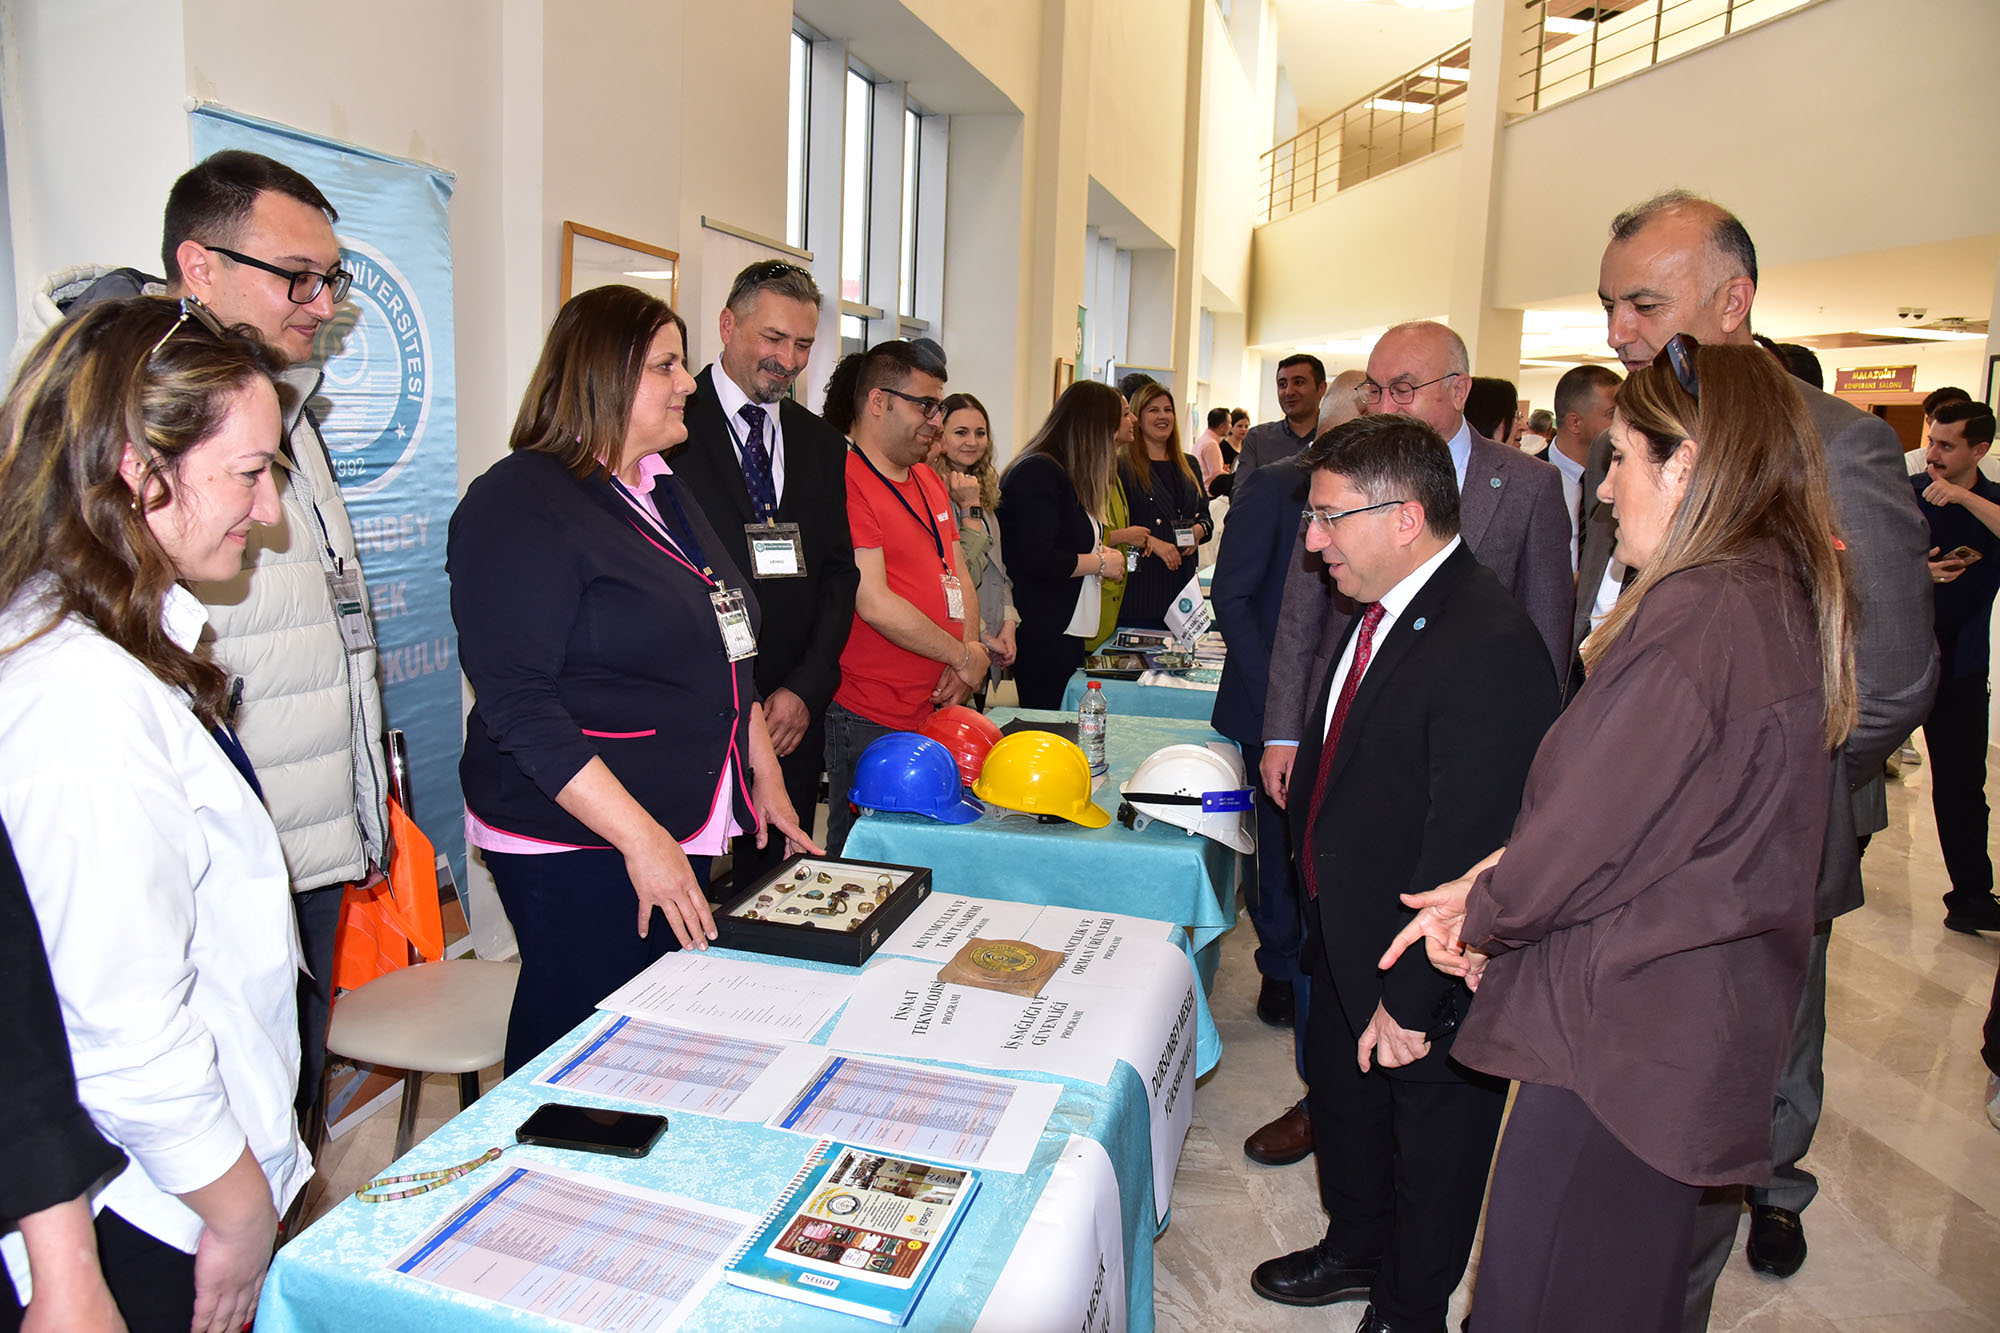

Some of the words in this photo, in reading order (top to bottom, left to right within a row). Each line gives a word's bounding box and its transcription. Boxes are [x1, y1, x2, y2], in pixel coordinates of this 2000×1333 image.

[340, 258, 423, 402] NİVERSİTESİ
[332, 457, 367, 477] 1992
[373, 581, 409, 620] EK
[377, 636, 449, 685] KULU
[912, 907, 960, 948] KUYUMCULUK
[952, 900, 967, 908] VE
[935, 932, 958, 948] TAKI
[950, 905, 983, 931] TASARIMI
[1080, 919, 1094, 927] VE
[1072, 951, 1096, 975] ORMAN
[1084, 918, 1115, 949] ÜRÜNLERİ
[1103, 936, 1123, 960] PROGRAMI
[890, 990, 919, 1020] İNŞAAT
[912, 980, 946, 1035] TEKNOLOJİSİ
[941, 994, 961, 1025] PROGRAMI
[1032, 995, 1049, 1004] VE
[1010, 1006, 1042, 1040] SAĞLIĞI
[1031, 1001, 1069, 1046] GÜVENLİĞİ
[1060, 1010, 1085, 1040] PROGRAMI
[1151, 1018, 1180, 1098] DURSUNBEY
[1177, 984, 1194, 1033] MESLEK
[1000, 1040, 1023, 1050] İŞ
[1164, 1033, 1192, 1121] YÜKSEKOKULU
